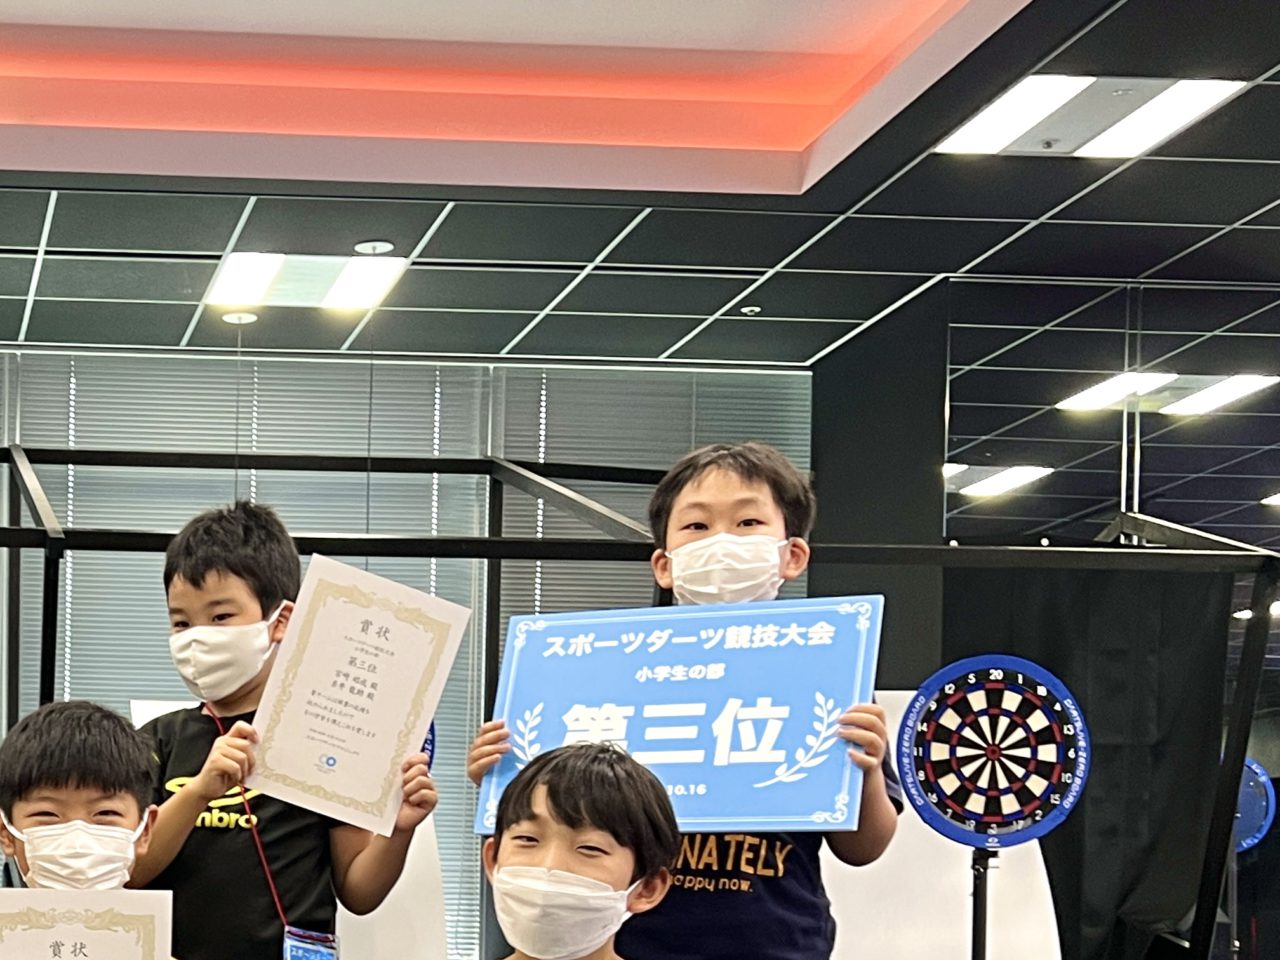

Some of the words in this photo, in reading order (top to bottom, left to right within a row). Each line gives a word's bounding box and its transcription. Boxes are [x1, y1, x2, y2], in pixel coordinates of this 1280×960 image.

[542, 621, 836, 658] スポーツダーツ競技大会
[635, 663, 726, 683] 小学生の部
[561, 697, 791, 767] 第三位
[676, 833, 793, 878] NATELY
[50, 941, 88, 959] 賞状
